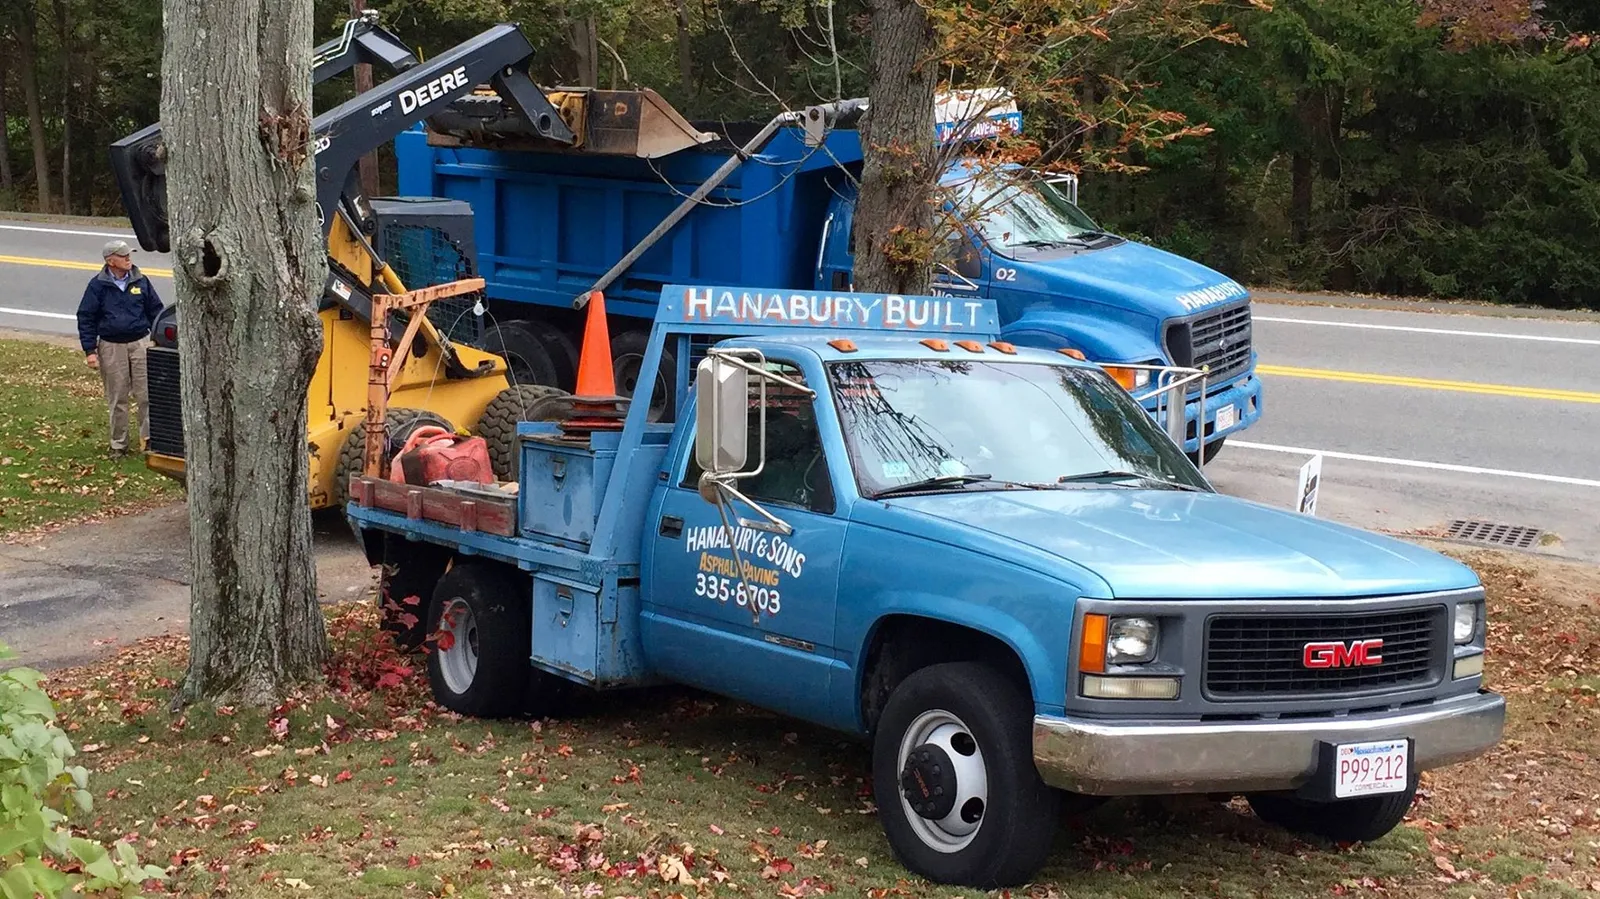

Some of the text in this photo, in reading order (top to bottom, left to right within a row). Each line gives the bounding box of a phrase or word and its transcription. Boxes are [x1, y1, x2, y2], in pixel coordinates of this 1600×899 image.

[398, 65, 469, 116] DEERE
[685, 287, 982, 328] HANABURY BUILT
[1175, 281, 1246, 311] HANABURY
[743, 559, 780, 586] PAVING
[766, 535, 806, 579] SONS
[1303, 638, 1384, 668] GMC
